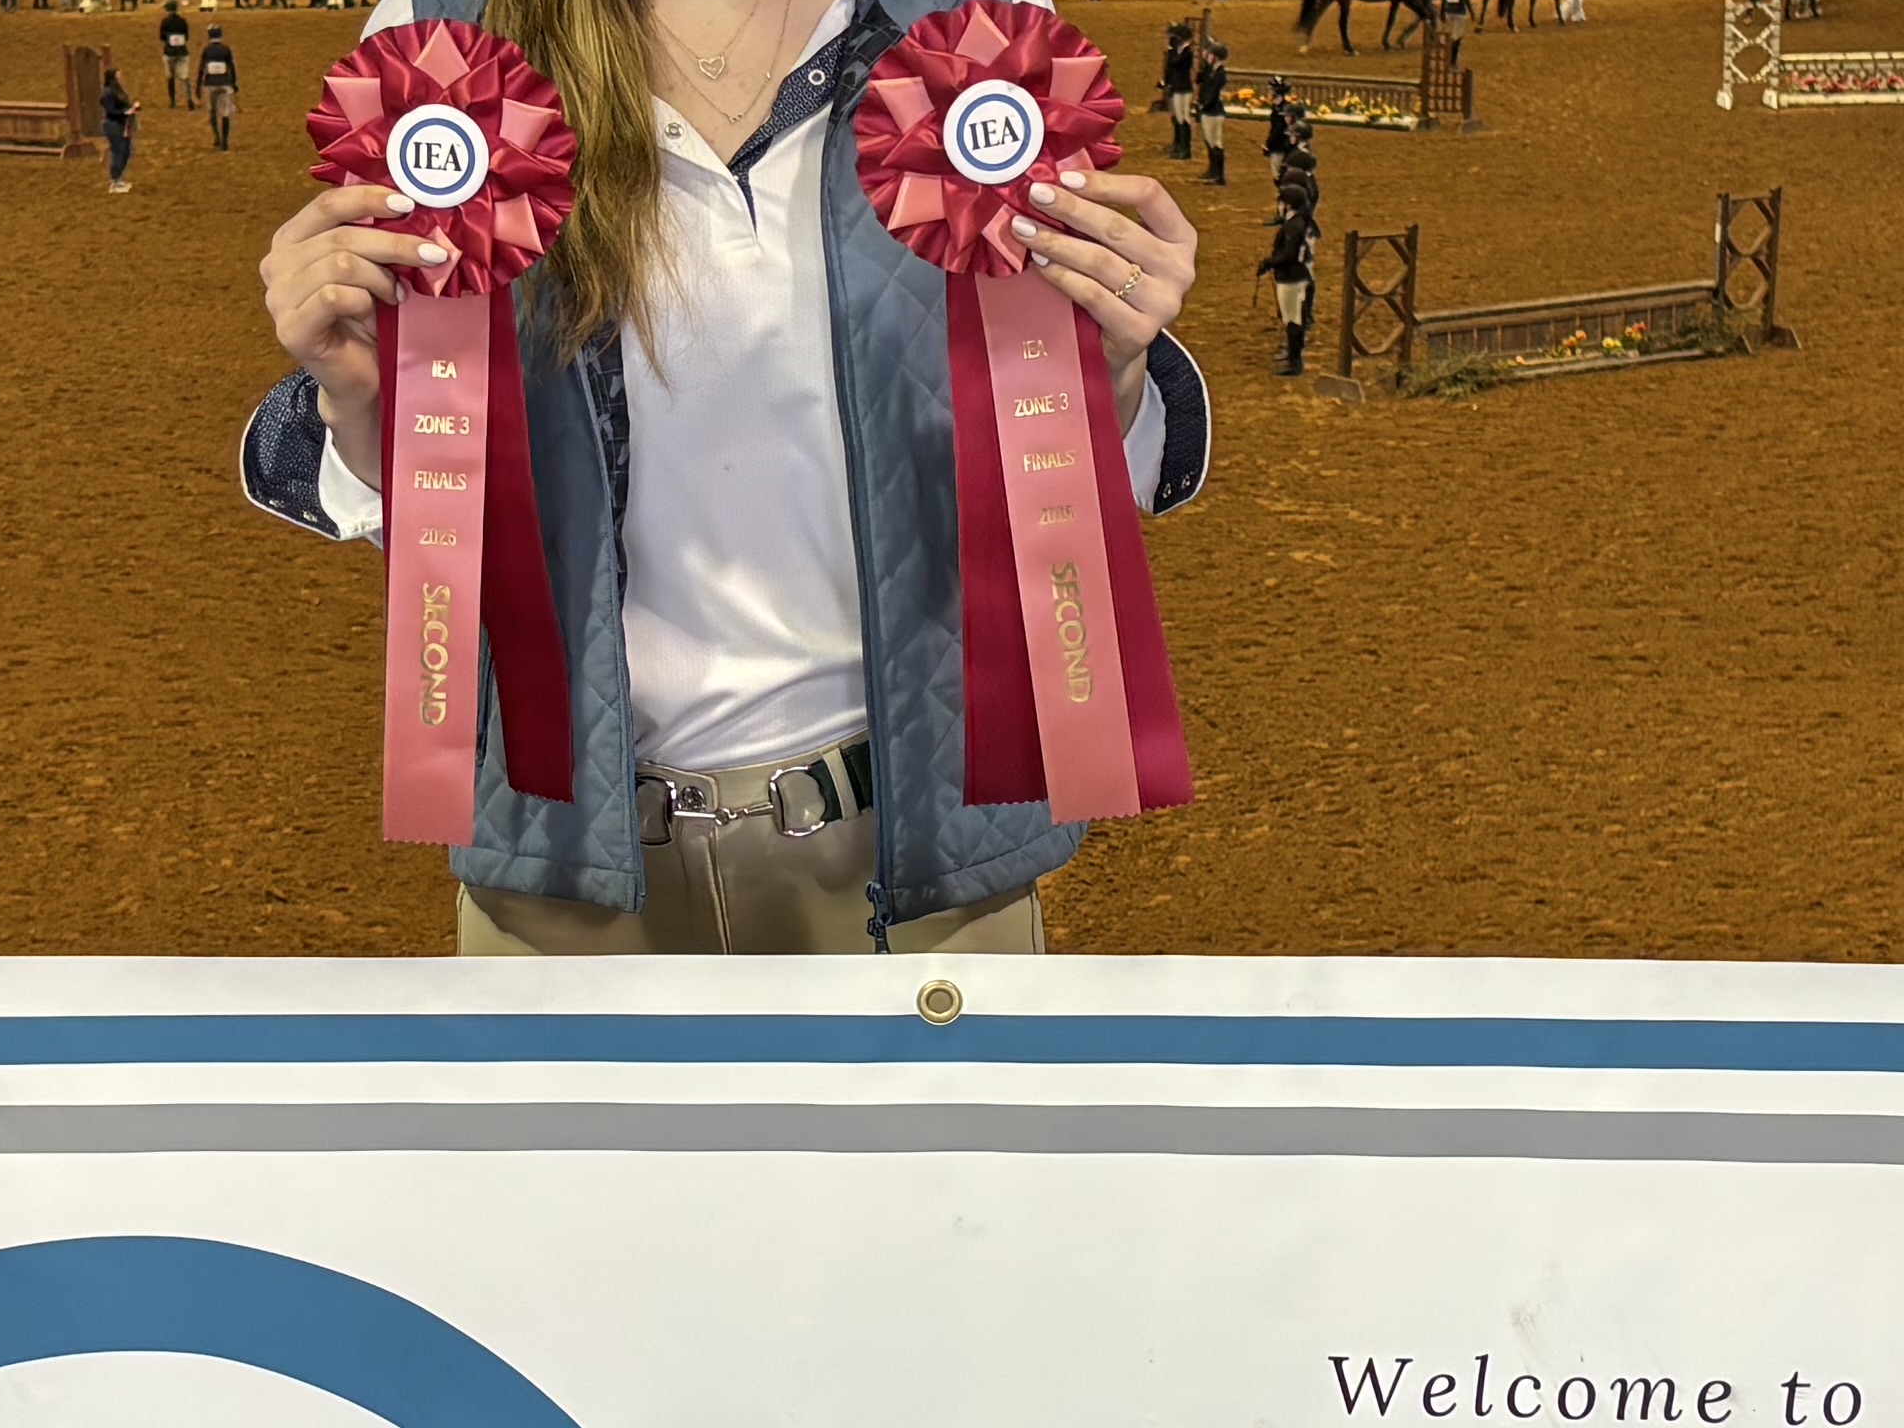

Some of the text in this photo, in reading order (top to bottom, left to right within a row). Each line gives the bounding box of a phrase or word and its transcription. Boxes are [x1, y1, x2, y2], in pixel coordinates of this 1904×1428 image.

[968, 116, 1021, 151] IEA
[412, 141, 463, 172] IEA
[1022, 339, 1048, 360] IEA
[431, 360, 457, 379] IEA
[1013, 392, 1069, 417] ZONE 3
[414, 414, 470, 435] ZONE 3
[1023, 448, 1077, 472] FINALS
[414, 470, 467, 491] FINALS
[1049, 560, 1093, 704] SECOND
[420, 582, 451, 725] SECOND
[1327, 1354, 1862, 1426] Welcome to
